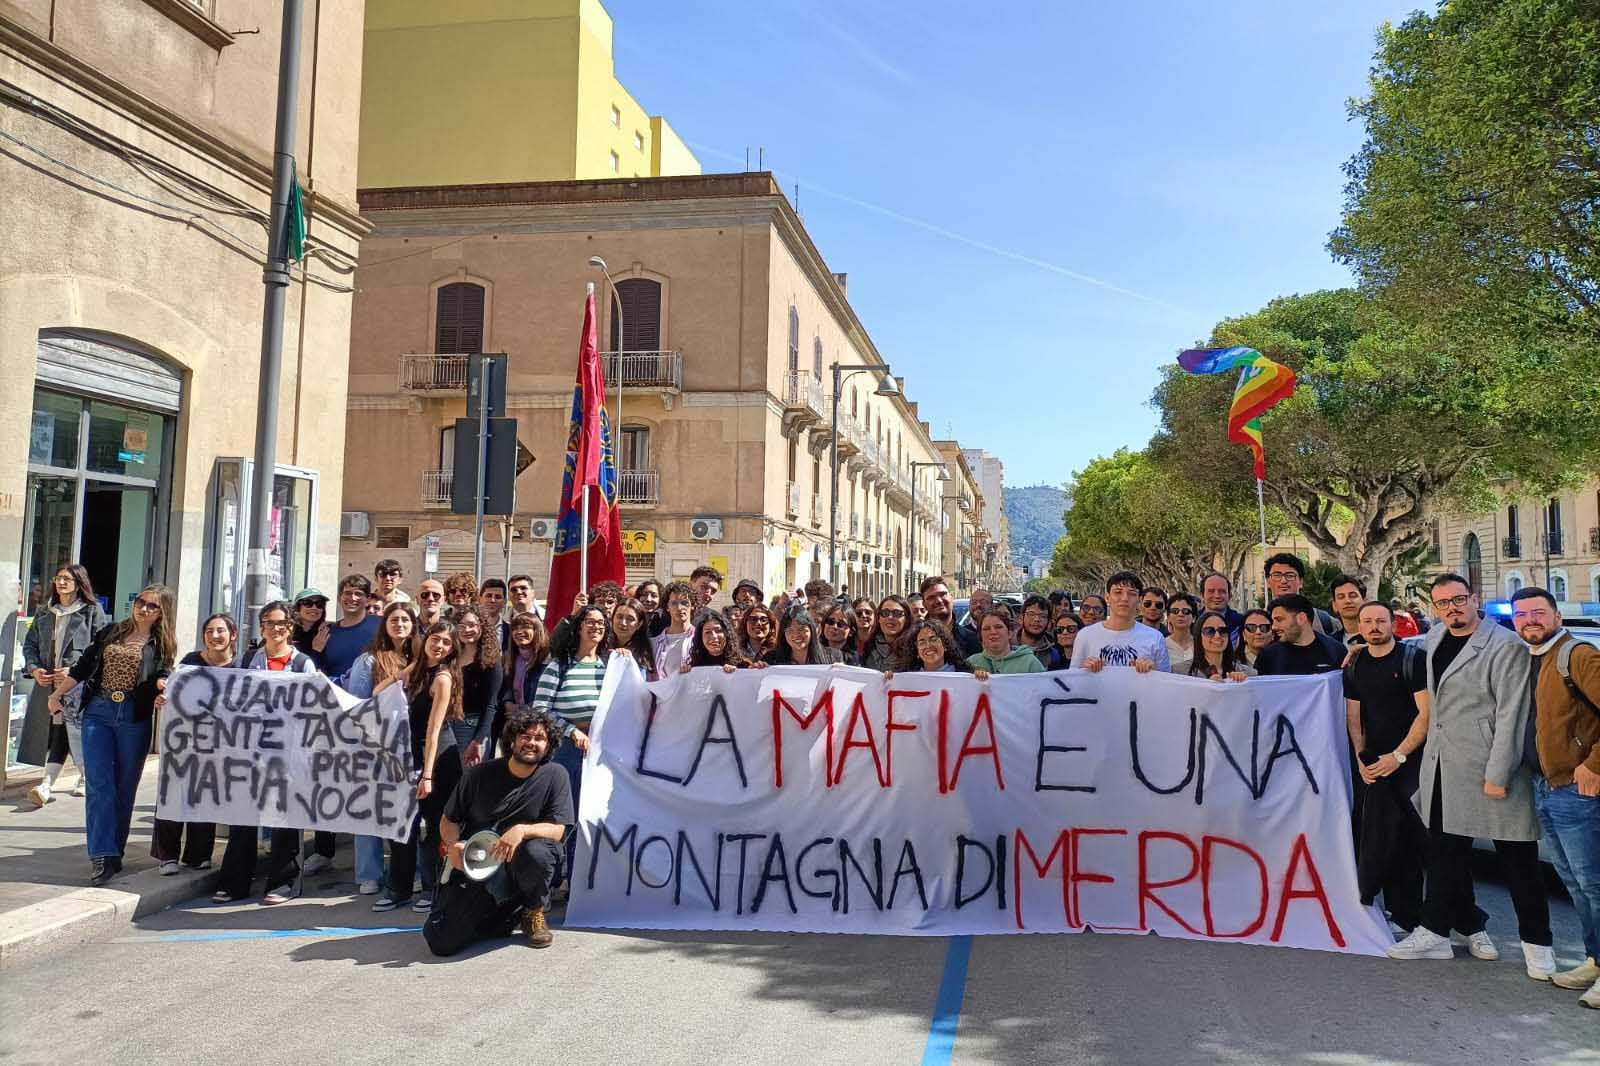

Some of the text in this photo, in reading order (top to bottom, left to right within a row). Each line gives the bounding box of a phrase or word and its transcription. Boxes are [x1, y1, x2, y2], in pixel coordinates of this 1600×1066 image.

[164, 714, 284, 754] GENTE
[637, 678, 1319, 805] LA MAFIA È UNA
[296, 783, 418, 838] VOCE!
[587, 819, 1347, 948] MONTAGNA DI MERDA
